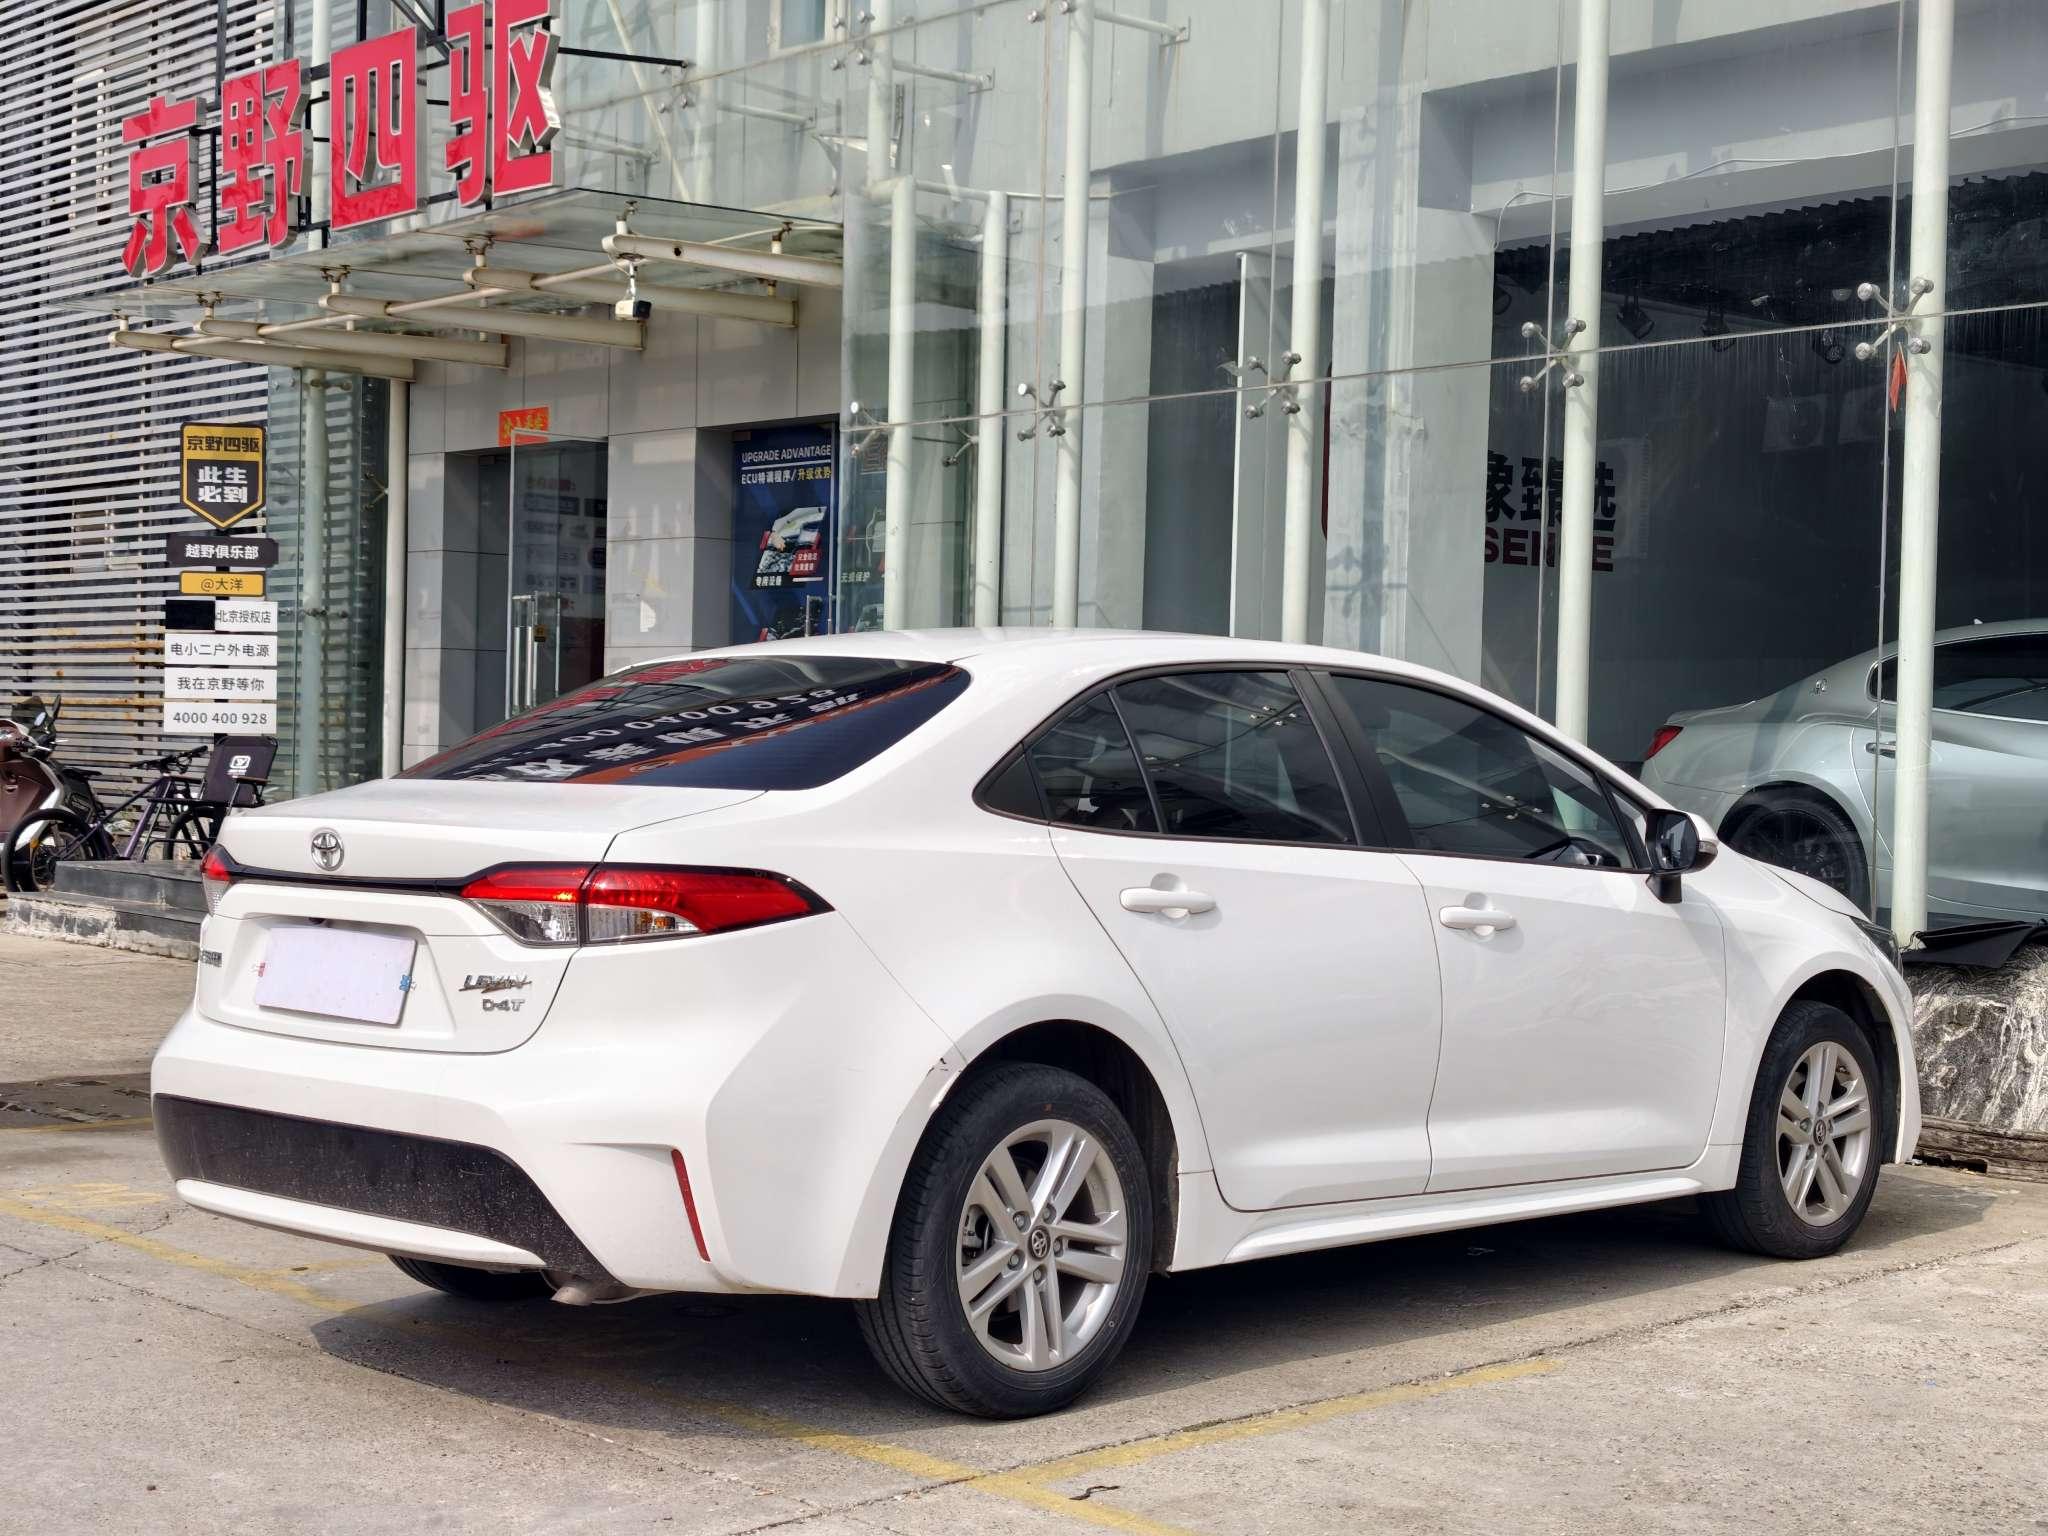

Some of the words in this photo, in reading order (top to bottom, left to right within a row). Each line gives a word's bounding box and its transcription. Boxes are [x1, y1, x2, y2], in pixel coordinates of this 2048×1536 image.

[122, 0, 556, 277] 京野四驱
[187, 435, 260, 453] 京野四驱
[741, 449, 780, 463] UPGRADE
[781, 445, 832, 460] ADVANTAGE
[197, 465, 248, 484] 此生
[197, 485, 248, 504] 必到
[185, 543, 259, 560] 越野俱乐部
[200, 577, 244, 593] @大洋
[216, 609, 272, 624] 北京授权店
[170, 643, 270, 658] 电小二户外电源
[177, 677, 265, 692] 我在京野等你
[173, 712, 208, 724] 4000
[211, 713, 238, 724] 400
[241, 713, 268, 725] 928
